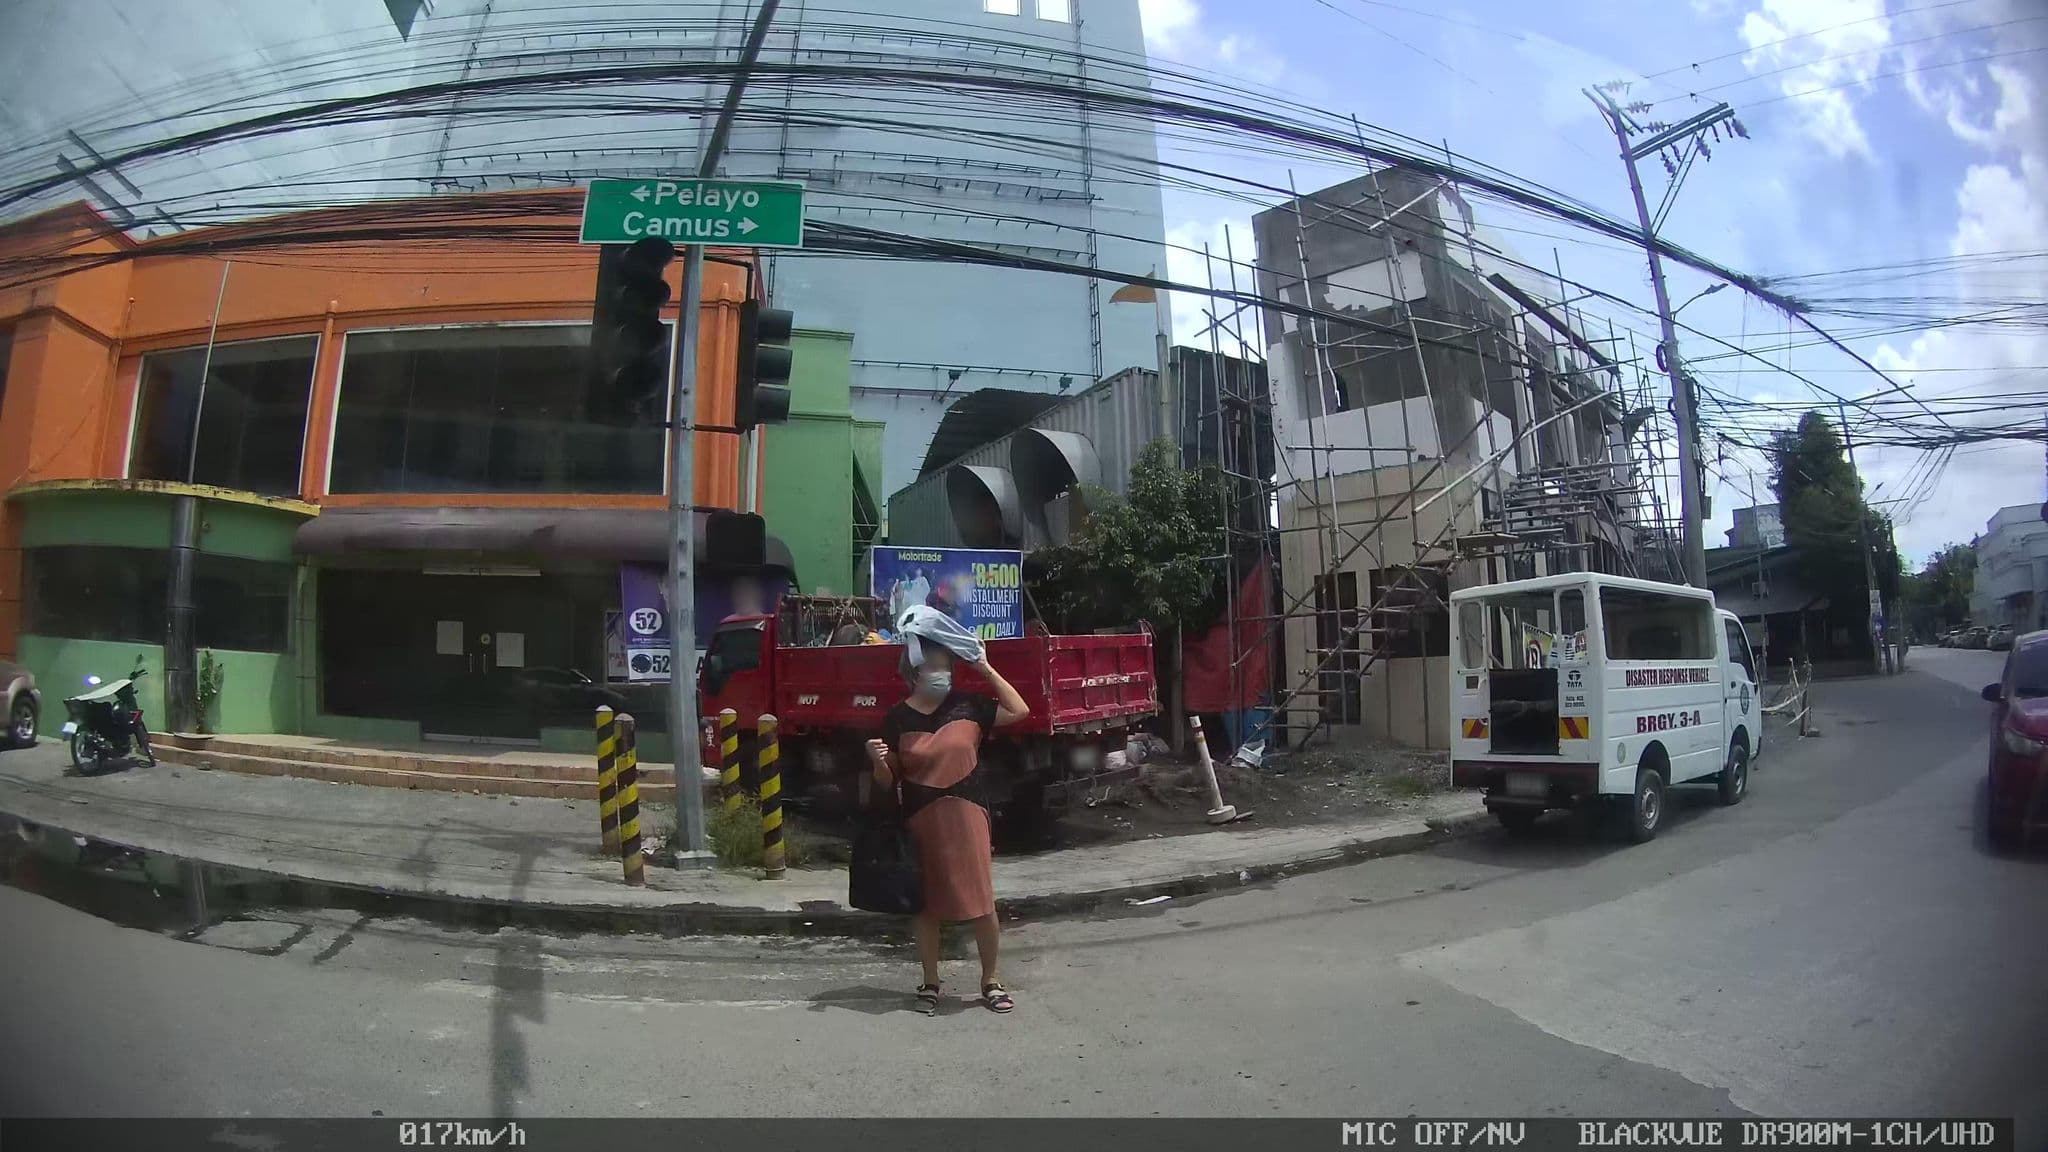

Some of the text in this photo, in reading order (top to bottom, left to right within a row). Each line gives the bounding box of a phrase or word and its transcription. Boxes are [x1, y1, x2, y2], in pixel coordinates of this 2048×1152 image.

[654, 182, 760, 212] Pelayo
[623, 211, 730, 237] Camus
[898, 552, 942, 561] Motortrade
[963, 589, 1020, 604] INSTALLMENT
[972, 604, 1011, 618] DISCOUNT
[635, 612, 658, 630] 52
[996, 621, 1017, 637] DAILY
[652, 655, 670, 673] 52
[1625, 667, 1710, 686] DISASTER RESPONSE VEHICLE
[853, 695, 877, 706] FOR
[1636, 710, 1701, 733] BRGY. 3-A
